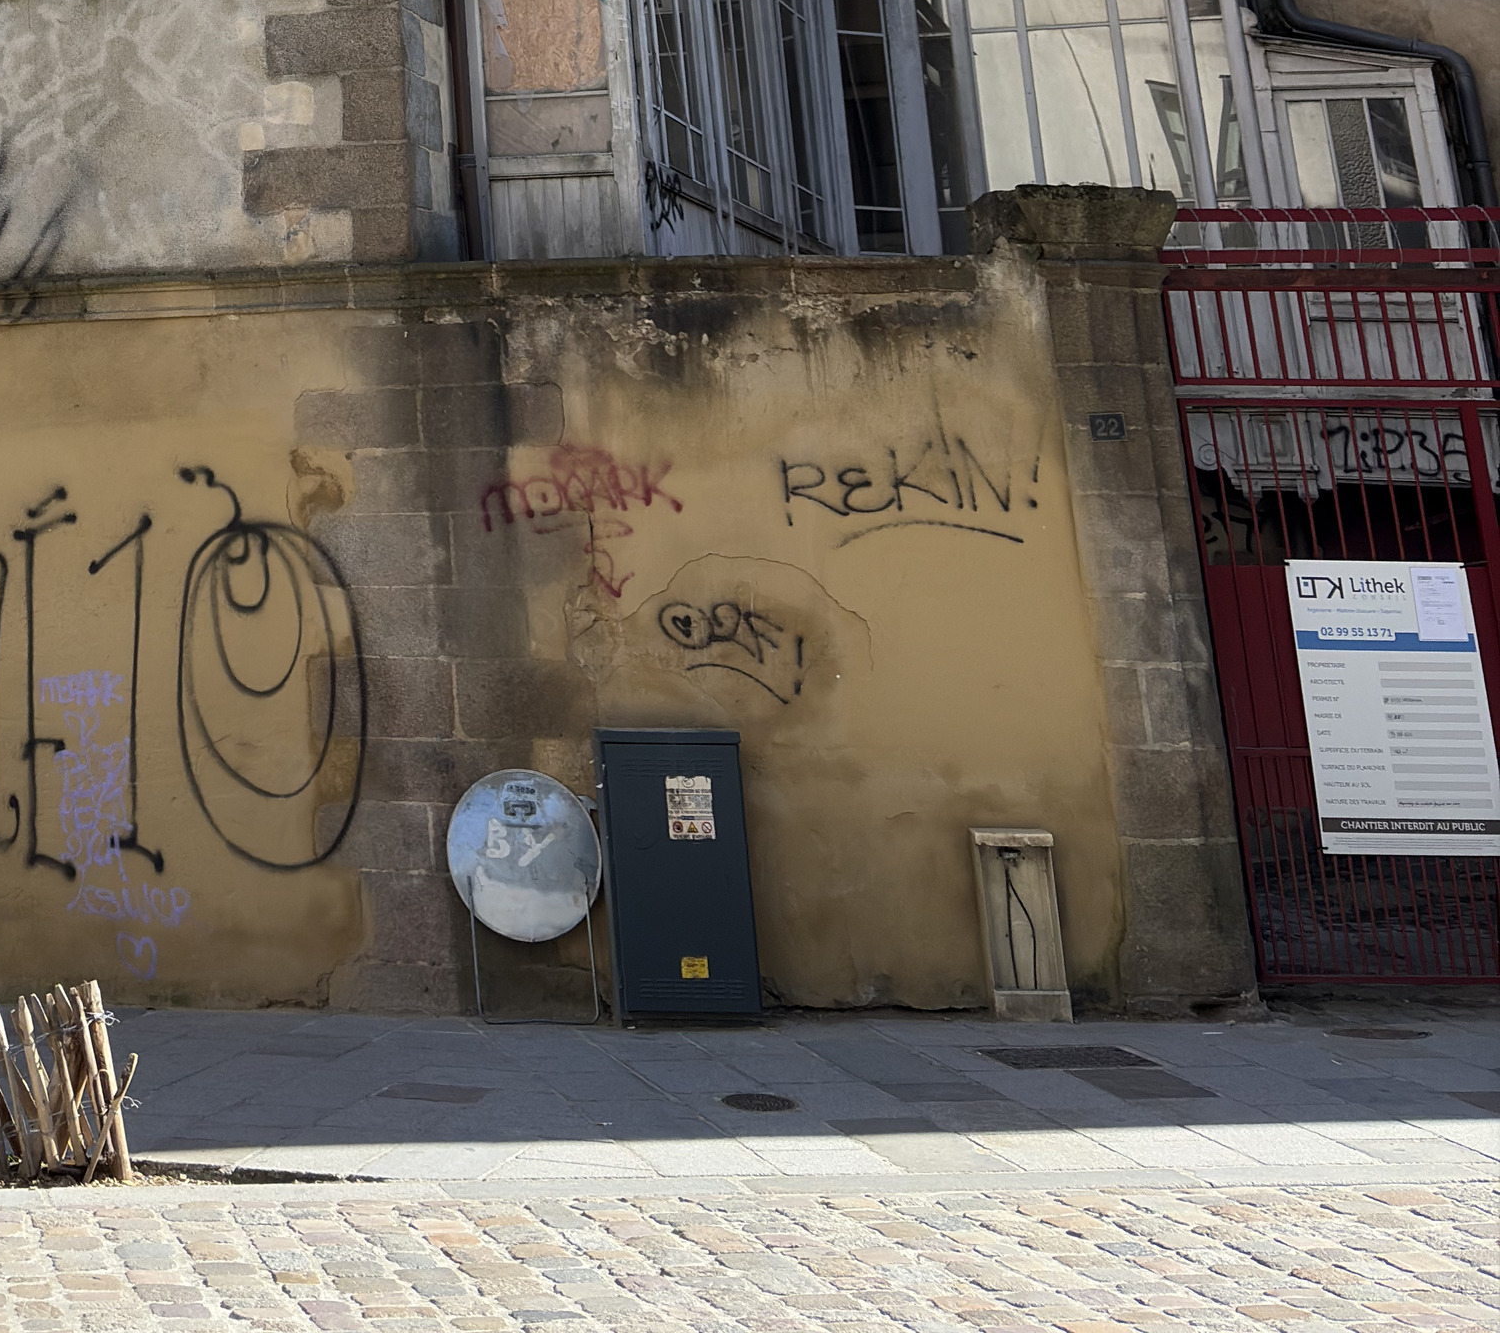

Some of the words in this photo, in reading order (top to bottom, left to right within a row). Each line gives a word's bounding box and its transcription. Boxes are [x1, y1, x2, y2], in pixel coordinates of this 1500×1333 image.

[1095, 419, 1120, 437] 22
[1349, 577, 1406, 594] Lithek
[1320, 626, 1334, 636] 02
[1336, 627, 1349, 636] 99
[1351, 627, 1364, 637] 55
[1367, 628, 1378, 637] 13
[1380, 628, 1393, 637] 71
[1340, 820, 1390, 830] CHANTIER
[1391, 821, 1435, 831] INTERDIT
[1436, 822, 1450, 831] AU
[1452, 822, 1486, 832] PUBLIC
